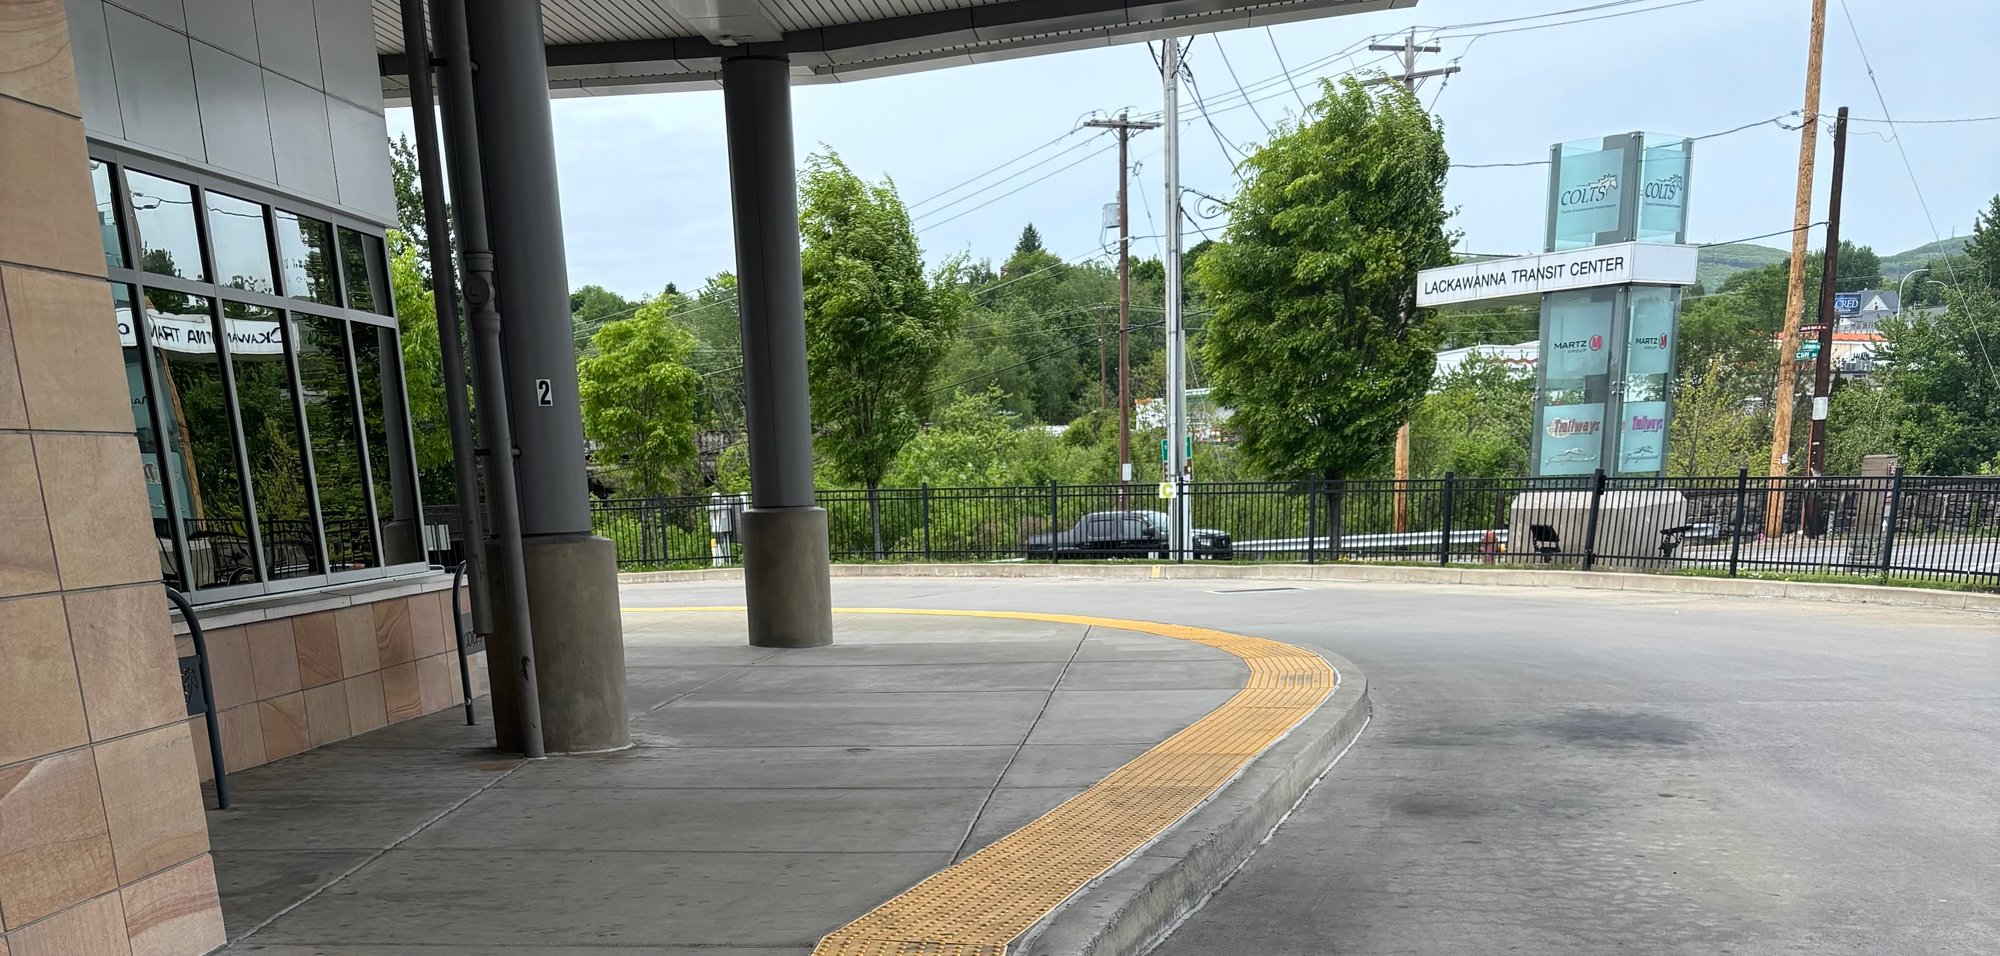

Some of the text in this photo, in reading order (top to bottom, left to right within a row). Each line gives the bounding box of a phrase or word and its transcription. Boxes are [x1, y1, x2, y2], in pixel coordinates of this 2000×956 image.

[1561, 185, 1606, 206] COLTS
[1645, 182, 1676, 200] COLTS
[1424, 257, 1624, 295] LACKAWANNA TRANSIT CENTER
[1554, 340, 1587, 350] MARTZ
[1635, 337, 1658, 345] MARTZ
[539, 380, 552, 405] 2
[1161, 483, 1174, 498] C
